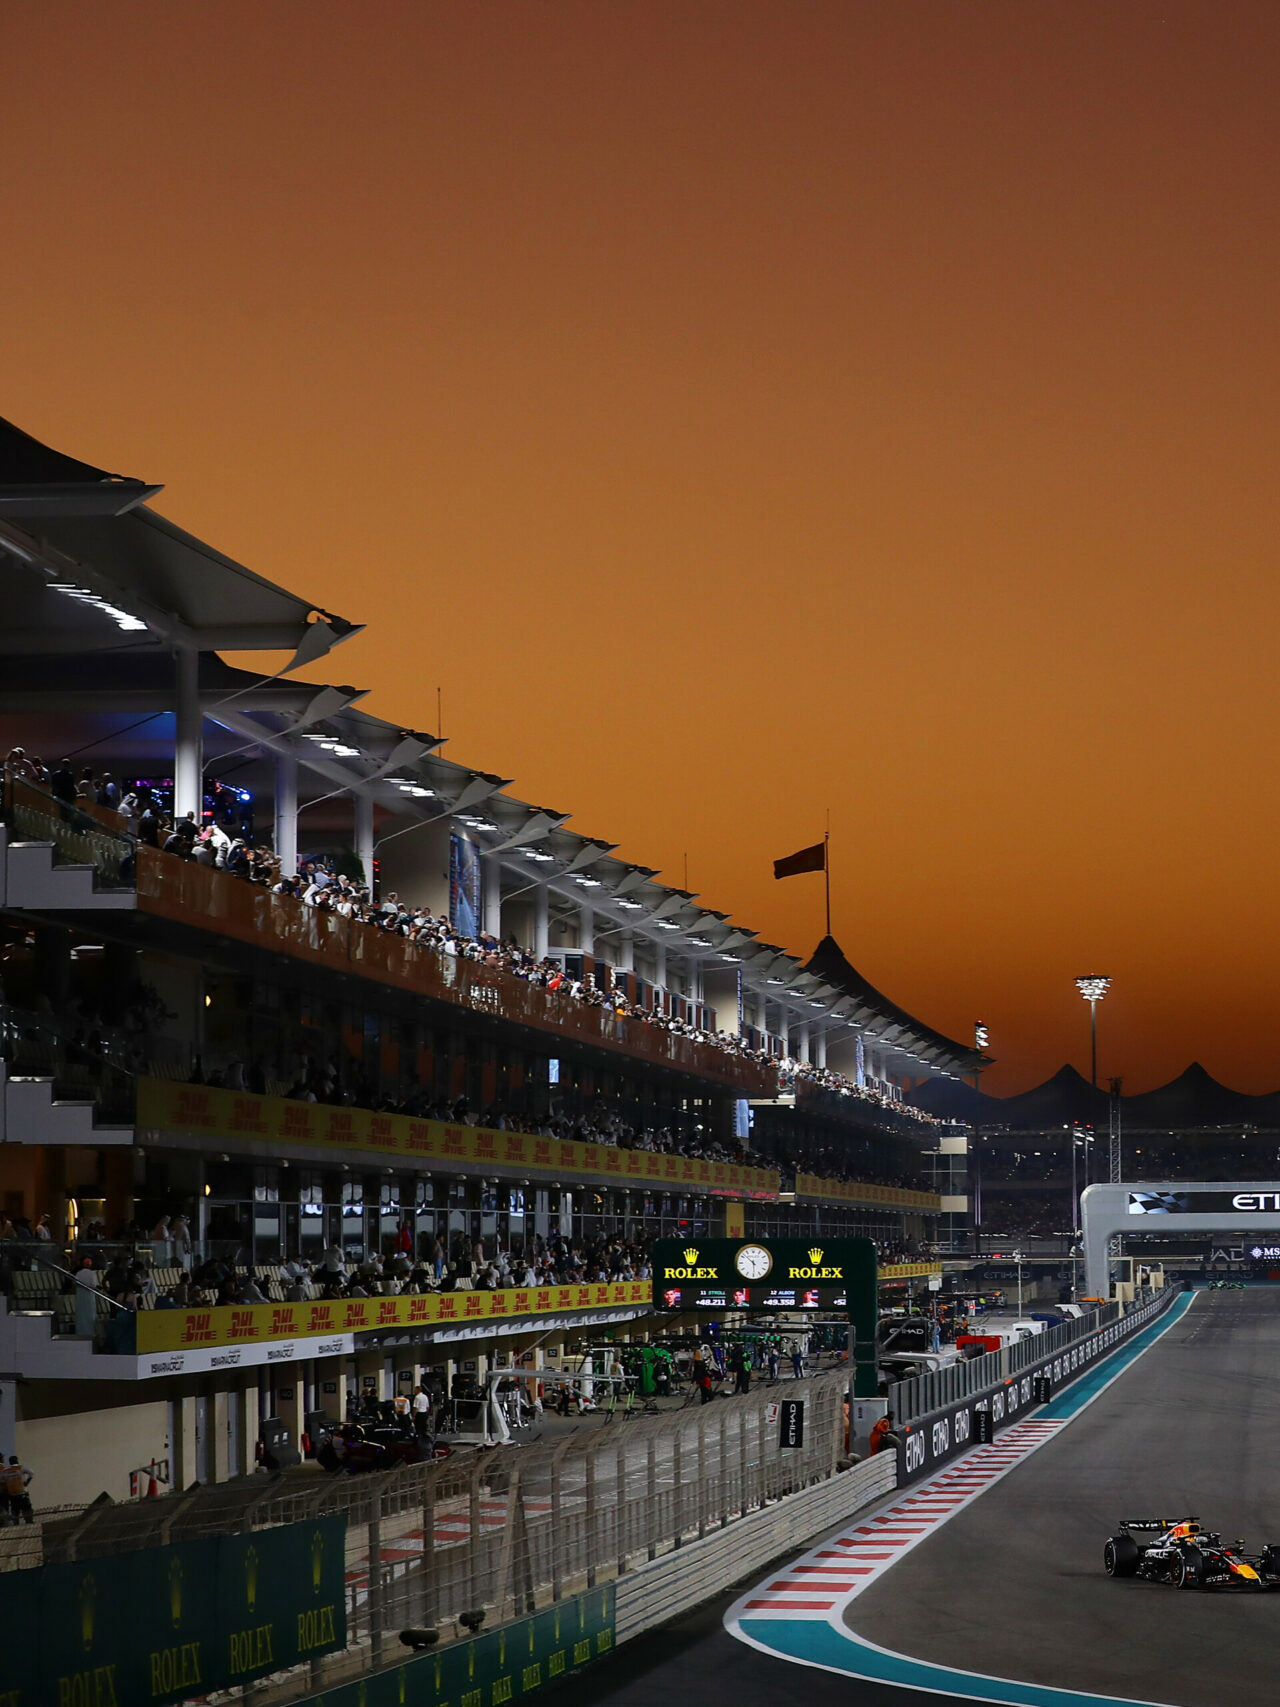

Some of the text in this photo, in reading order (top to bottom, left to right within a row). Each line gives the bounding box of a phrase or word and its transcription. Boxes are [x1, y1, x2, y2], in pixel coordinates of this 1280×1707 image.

[279, 1106, 315, 1139] DHL
[324, 1112, 358, 1143] DHL
[366, 1117, 398, 1147] DHL
[406, 1122, 433, 1151] DHL
[441, 1128, 467, 1156] DHL
[664, 1267, 719, 1279] ROLEX
[788, 1267, 844, 1279] ROLEX
[181, 1314, 217, 1343] DHL
[227, 1311, 259, 1339] DHL
[268, 1308, 299, 1335] DHL
[307, 1306, 335, 1331] DHL
[343, 1303, 369, 1327] DHL
[377, 1301, 400, 1325] DHL
[407, 1299, 430, 1321] DHL
[436, 1297, 457, 1319] DHL
[464, 1295, 484, 1317] DHL
[490, 1294, 508, 1315] DHL
[513, 1292, 531, 1312] DHL
[788, 1403, 797, 1445] ETIHAD
[905, 1429, 926, 1474] ETIHAD
[932, 1417, 950, 1458] ETIHAD
[954, 1408, 970, 1444] ETIHAD
[151, 1642, 202, 1696] ROLEX
[230, 1624, 274, 1674] ROLEX
[297, 1605, 336, 1652] ROLEX
